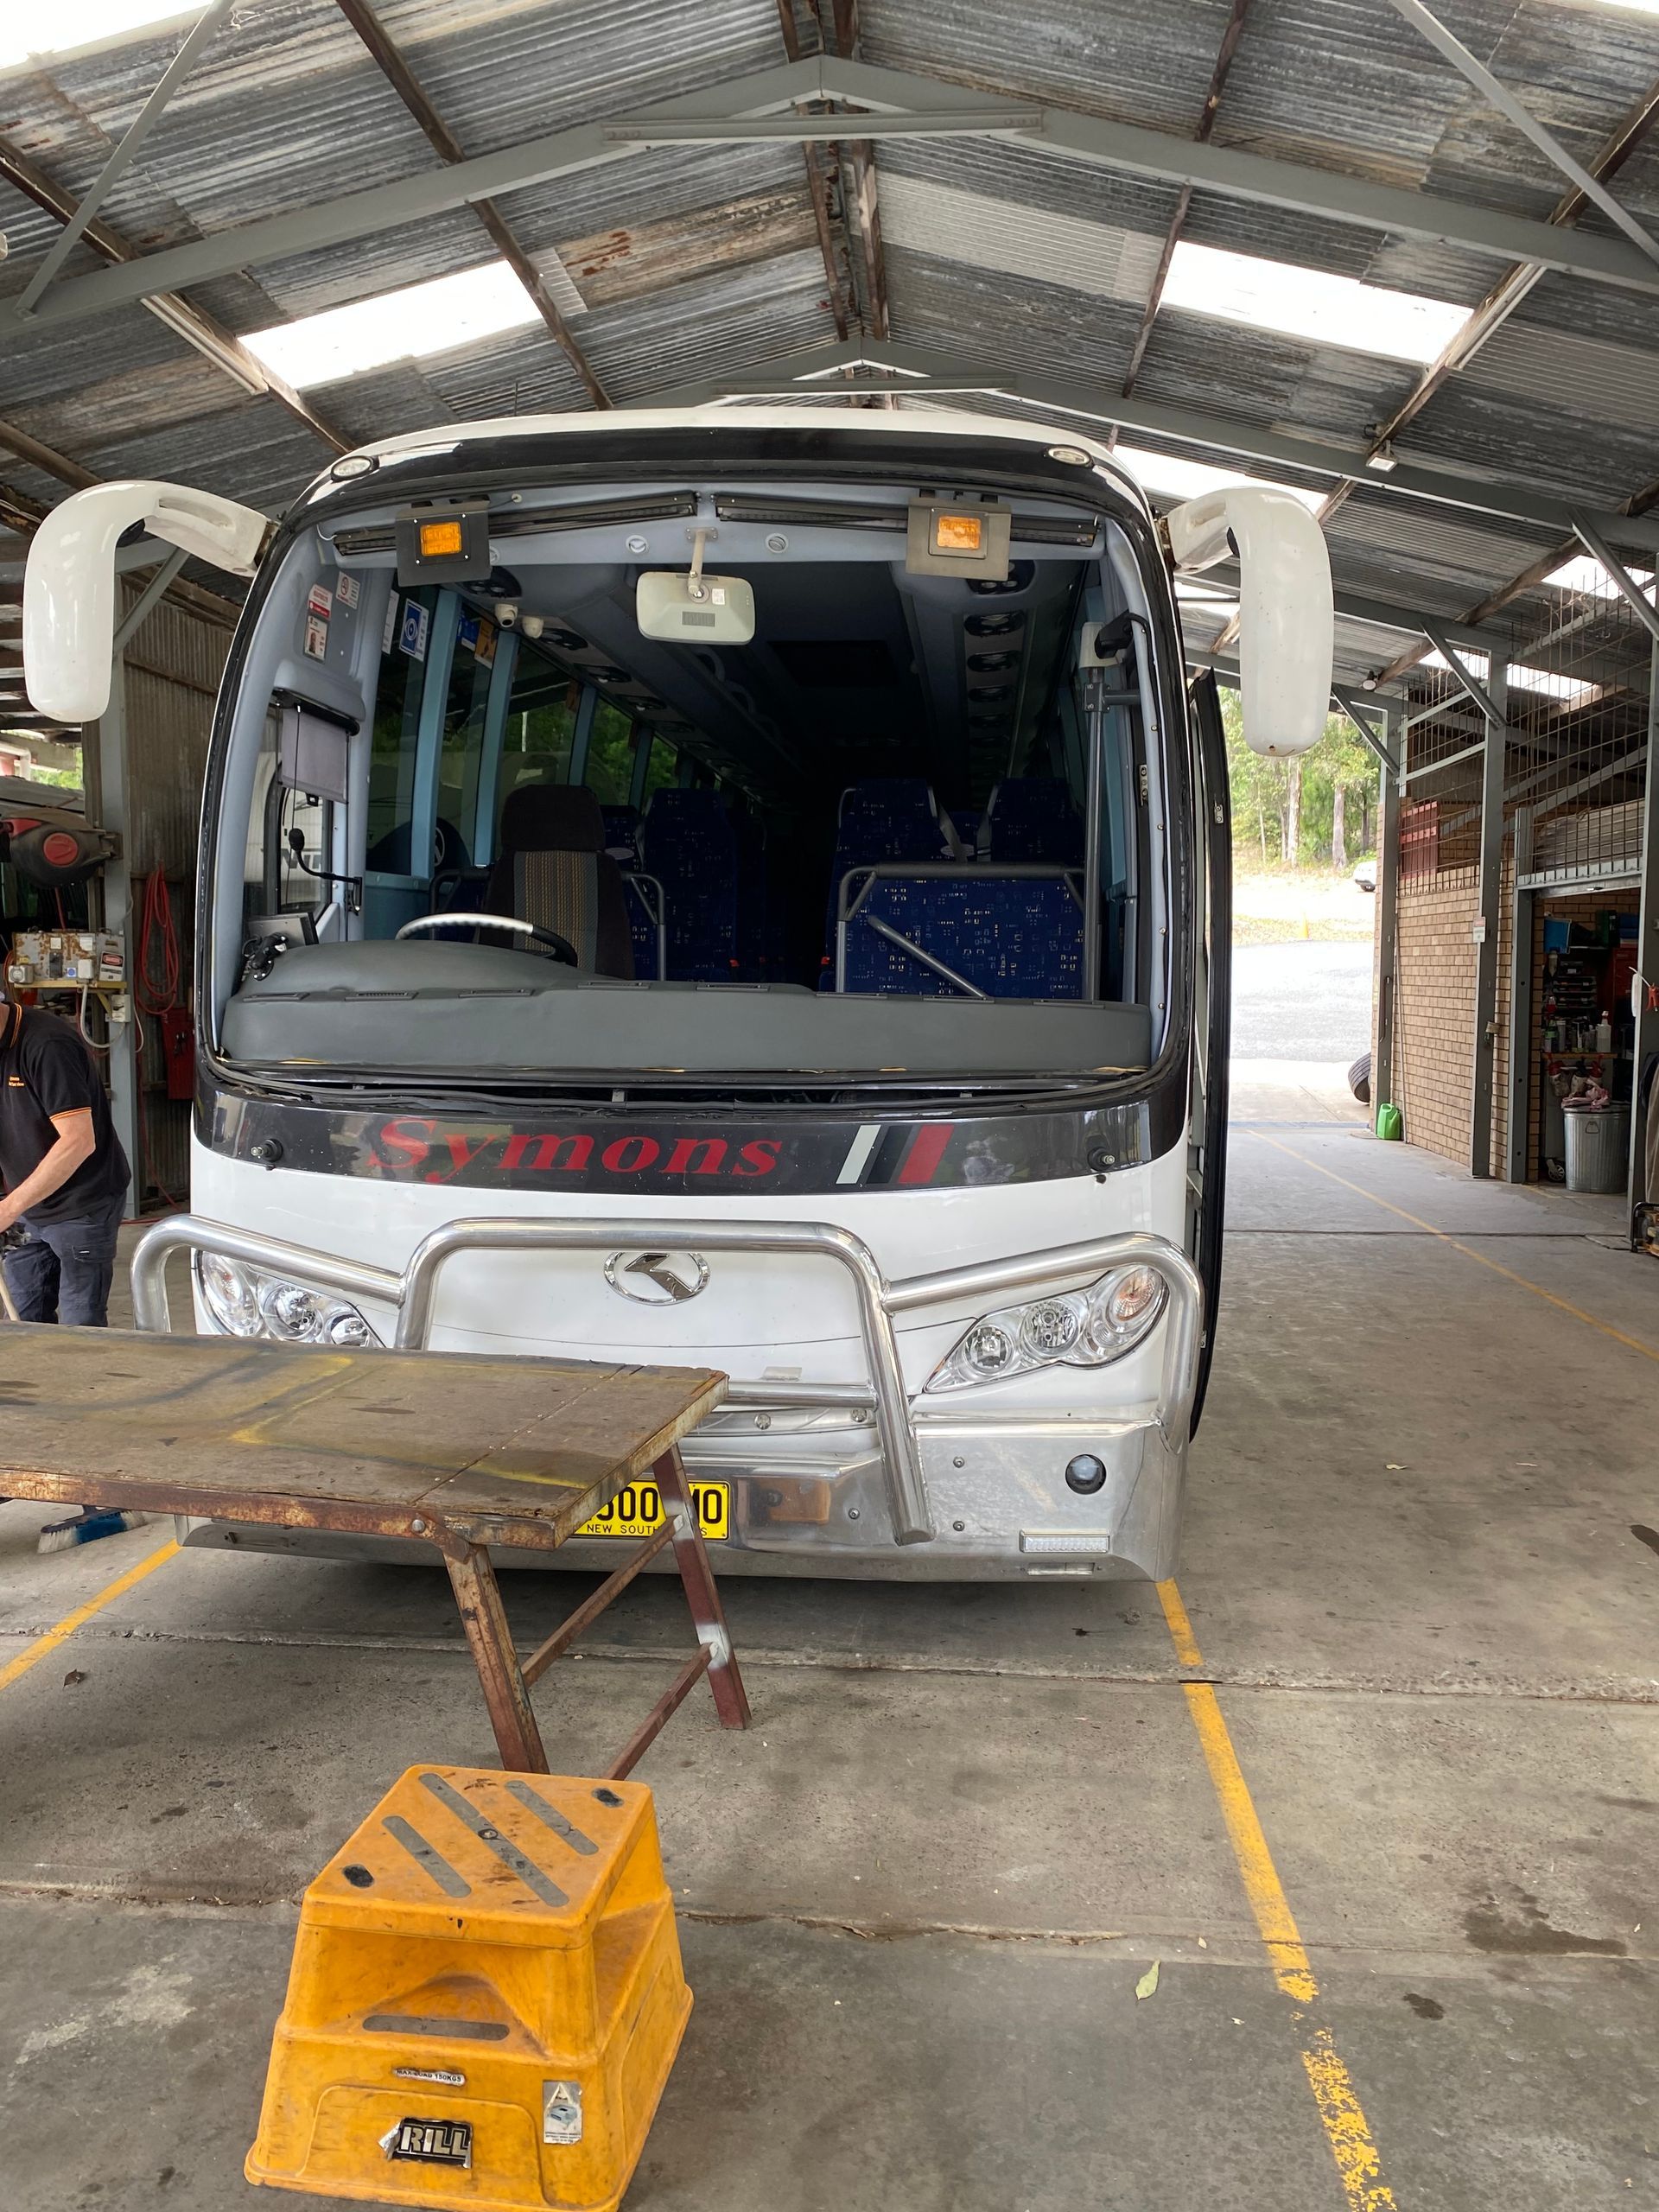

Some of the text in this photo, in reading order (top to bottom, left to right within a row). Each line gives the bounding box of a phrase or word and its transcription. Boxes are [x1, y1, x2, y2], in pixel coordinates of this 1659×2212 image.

[365, 1117, 782, 1183] Symons
[587, 1523, 613, 1534] NEW
[400, 2126, 467, 2156] RILL
